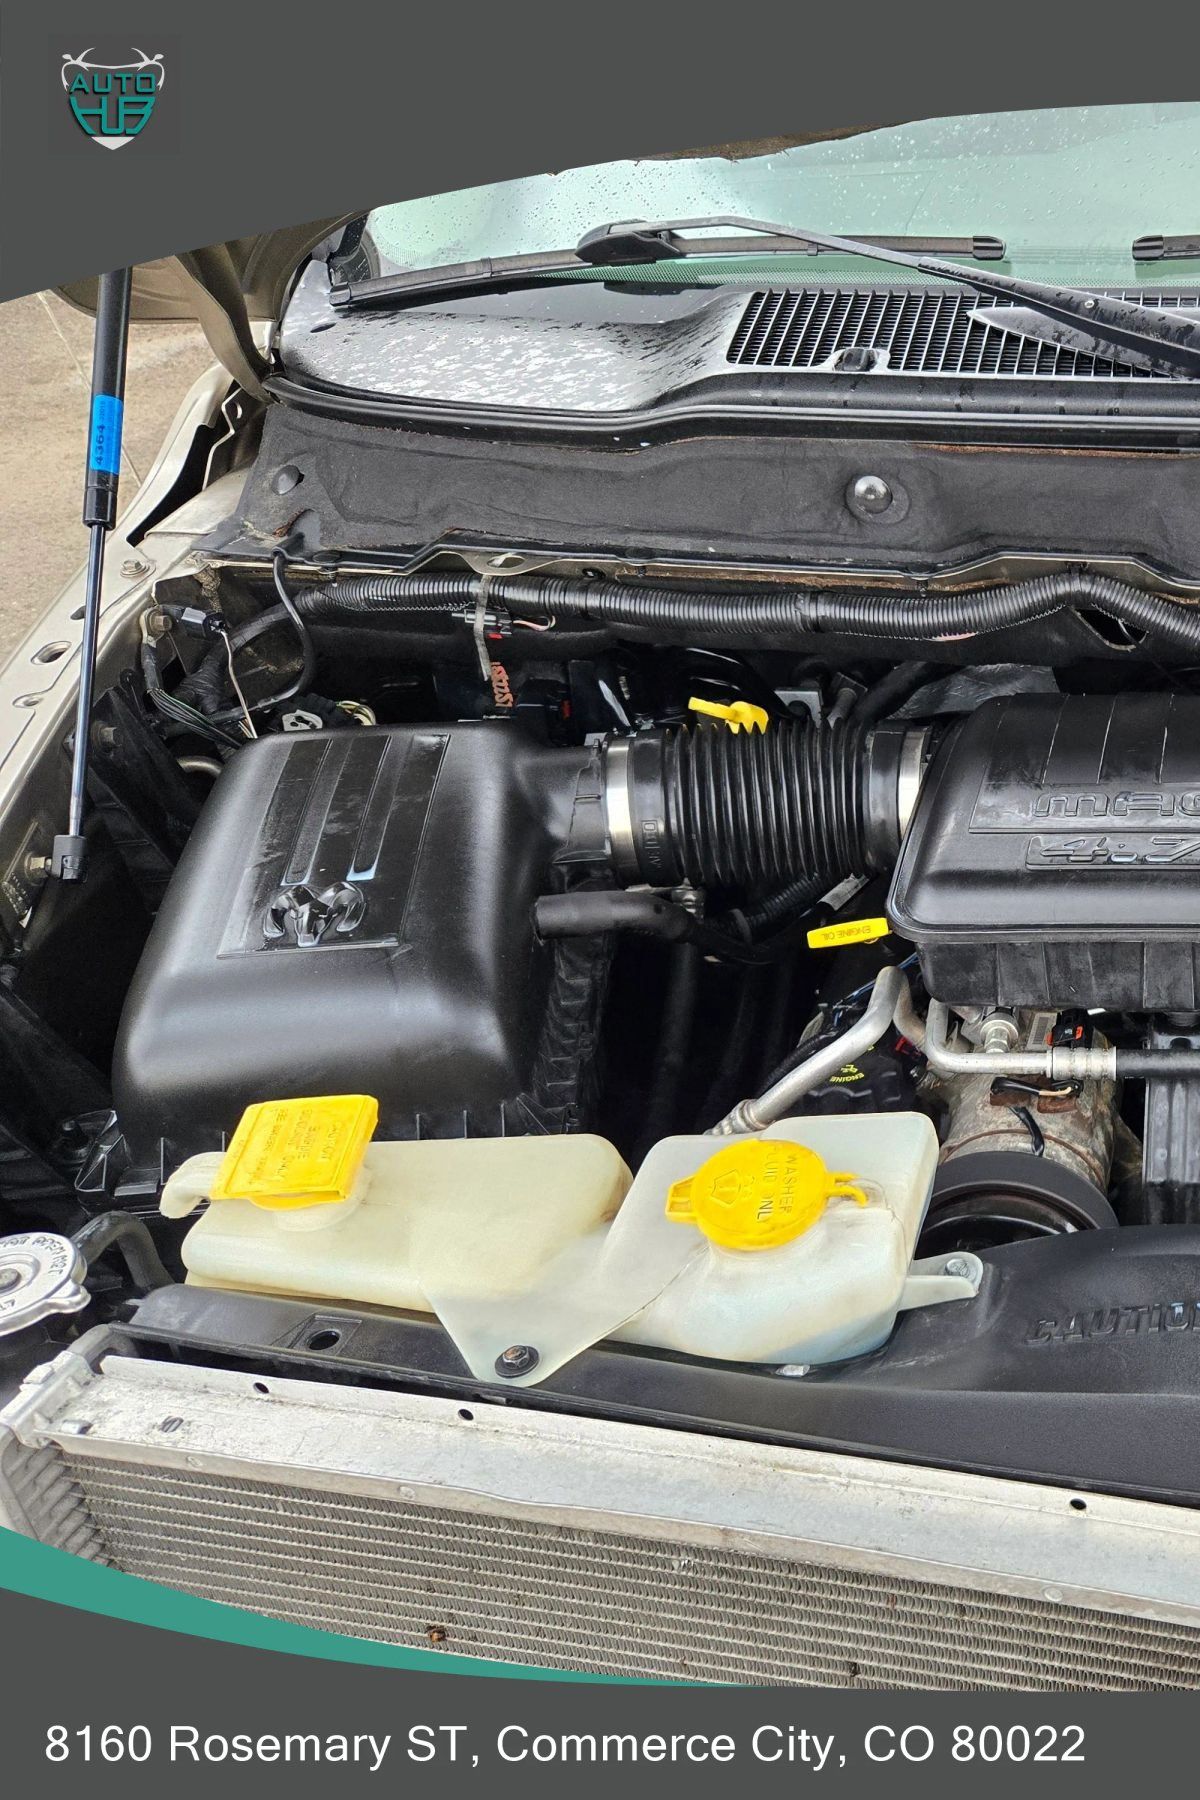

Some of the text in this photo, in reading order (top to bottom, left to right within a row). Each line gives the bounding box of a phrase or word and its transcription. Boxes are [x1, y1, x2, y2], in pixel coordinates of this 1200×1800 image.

[822, 926, 872, 941] ENGINE OIL
[829, 1072, 865, 1083] ENGINE
[762, 1144, 779, 1183] FLUID
[778, 1153, 798, 1214] WASHER
[32, 1236, 66, 1255] OPEN
[47, 1255, 68, 1275] HOT
